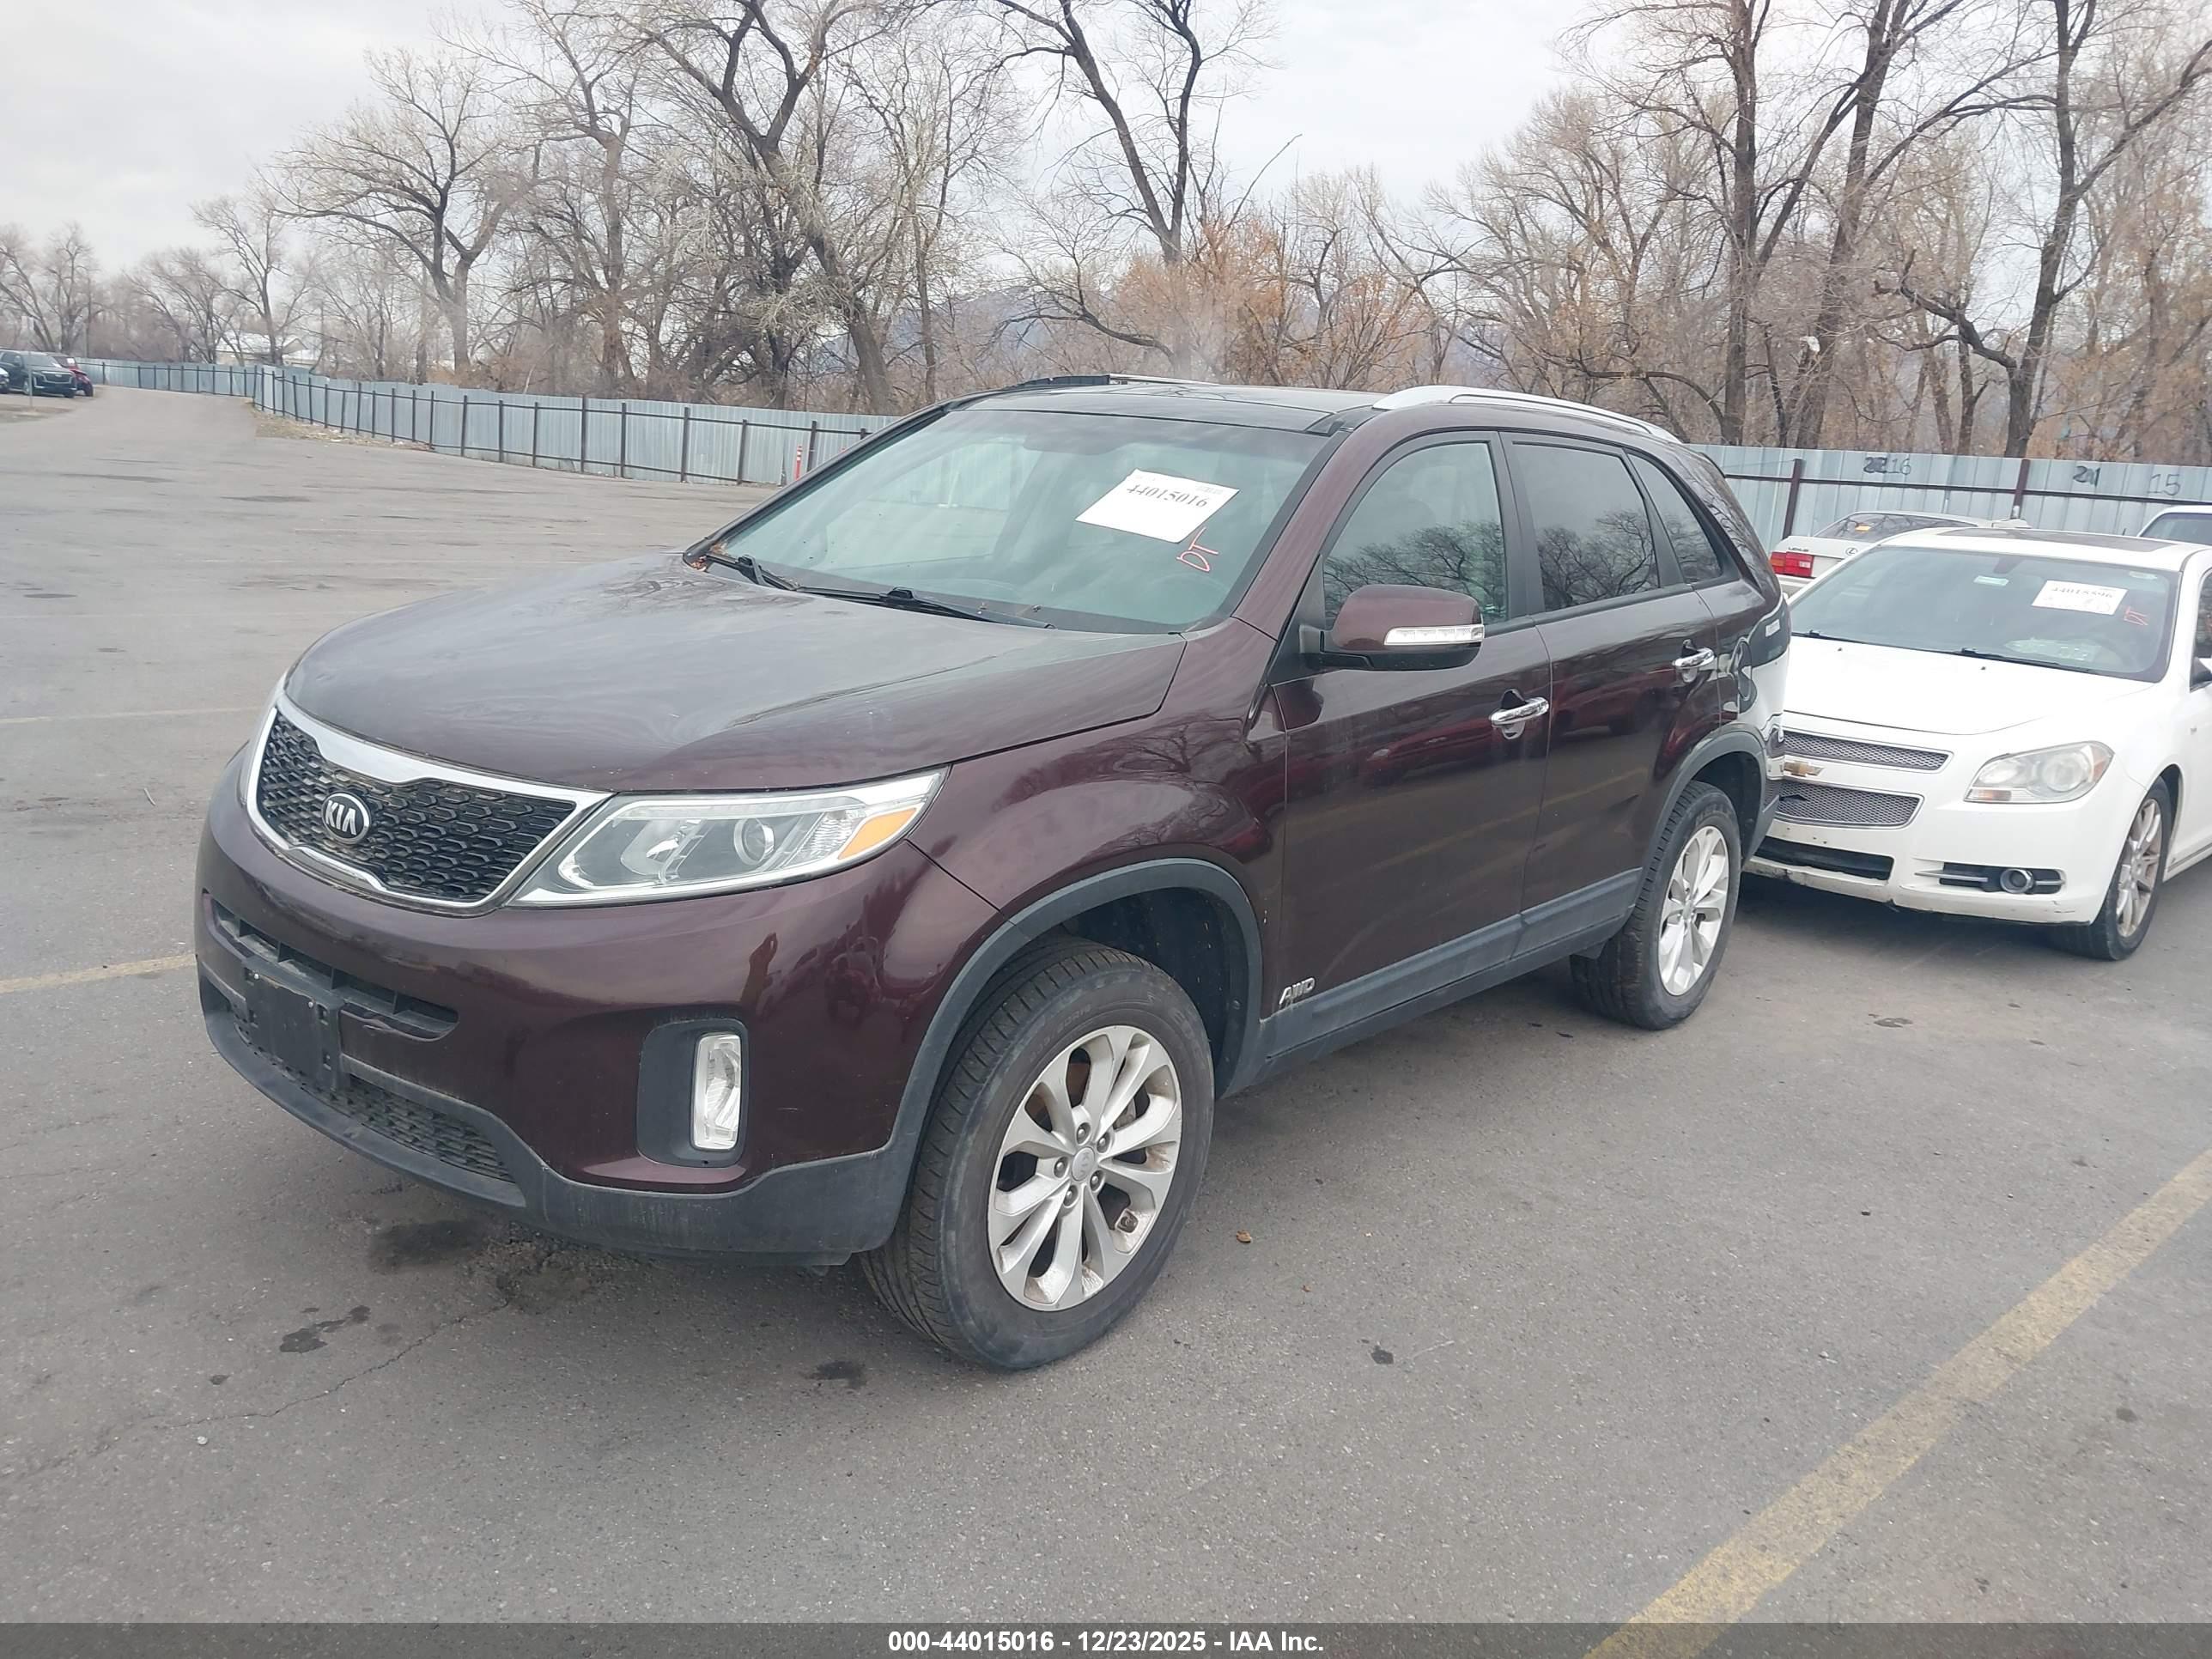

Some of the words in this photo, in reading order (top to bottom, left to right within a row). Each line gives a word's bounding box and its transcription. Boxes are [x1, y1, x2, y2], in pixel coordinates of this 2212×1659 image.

[1127, 483, 1208, 507] 44015016
[2148, 473, 2181, 496] 15
[325, 799, 357, 836] KIA
[1279, 977, 1316, 1009] AWD
